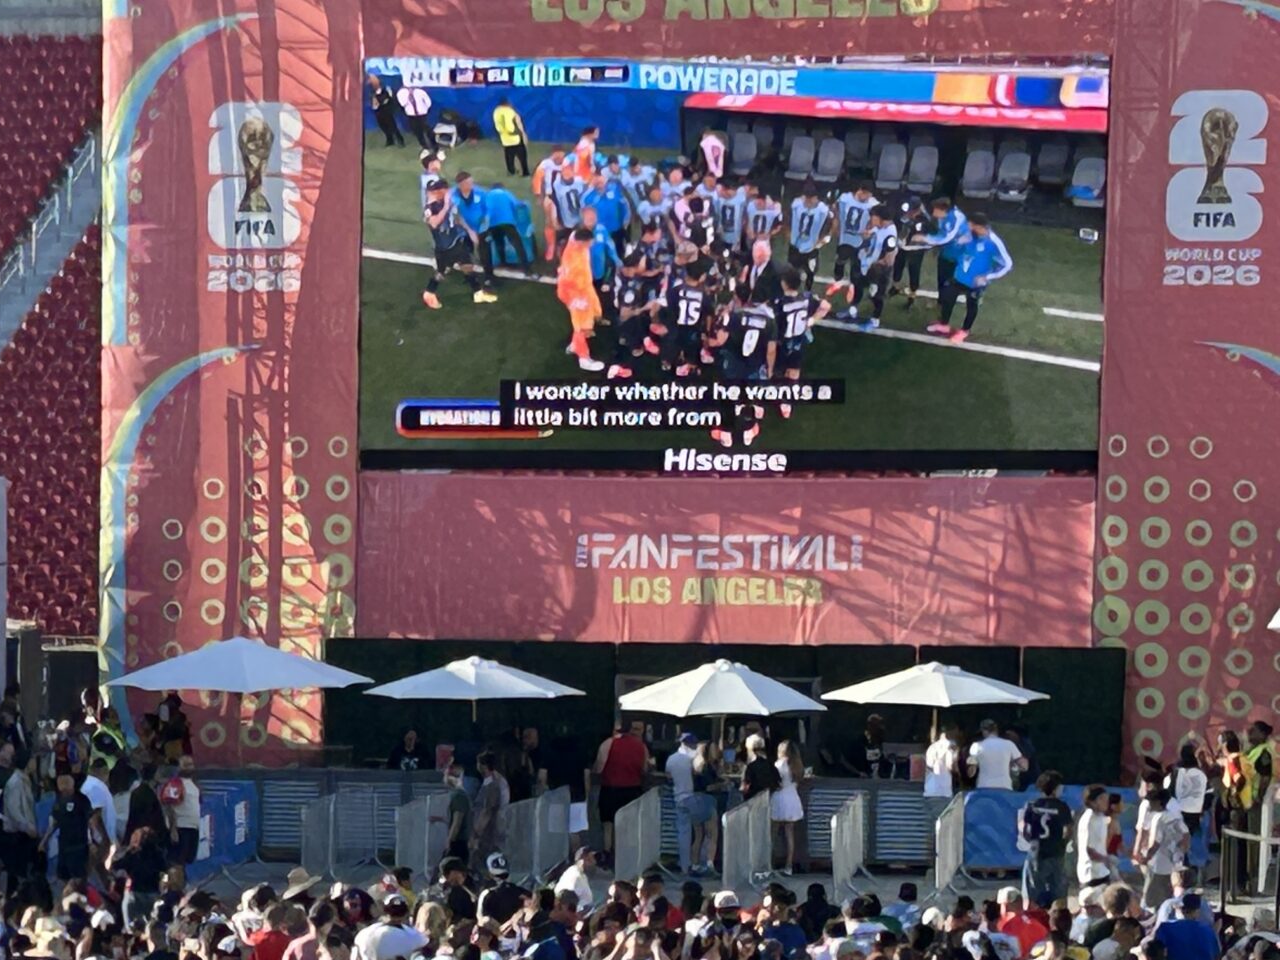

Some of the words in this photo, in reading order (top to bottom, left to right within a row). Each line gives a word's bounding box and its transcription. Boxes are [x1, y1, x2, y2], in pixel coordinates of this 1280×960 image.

[640, 65, 798, 96] POWERADE
[1193, 212, 1236, 228] FIFA
[1164, 248, 1224, 261] WORLD
[1228, 248, 1263, 261] CUP
[1162, 265, 1261, 286] 2026
[677, 300, 701, 325] 15
[525, 383, 610, 400] wonder
[615, 383, 708, 400] whether
[713, 383, 740, 400] he
[746, 384, 814, 400] wants
[818, 387, 832, 400] a
[513, 407, 563, 426] little
[569, 407, 597, 426] bit
[603, 412, 662, 426] more
[667, 408, 721, 426] from
[664, 448, 787, 472] Hisense
[612, 576, 672, 605] LOS
[681, 577, 823, 606] ANGELES
